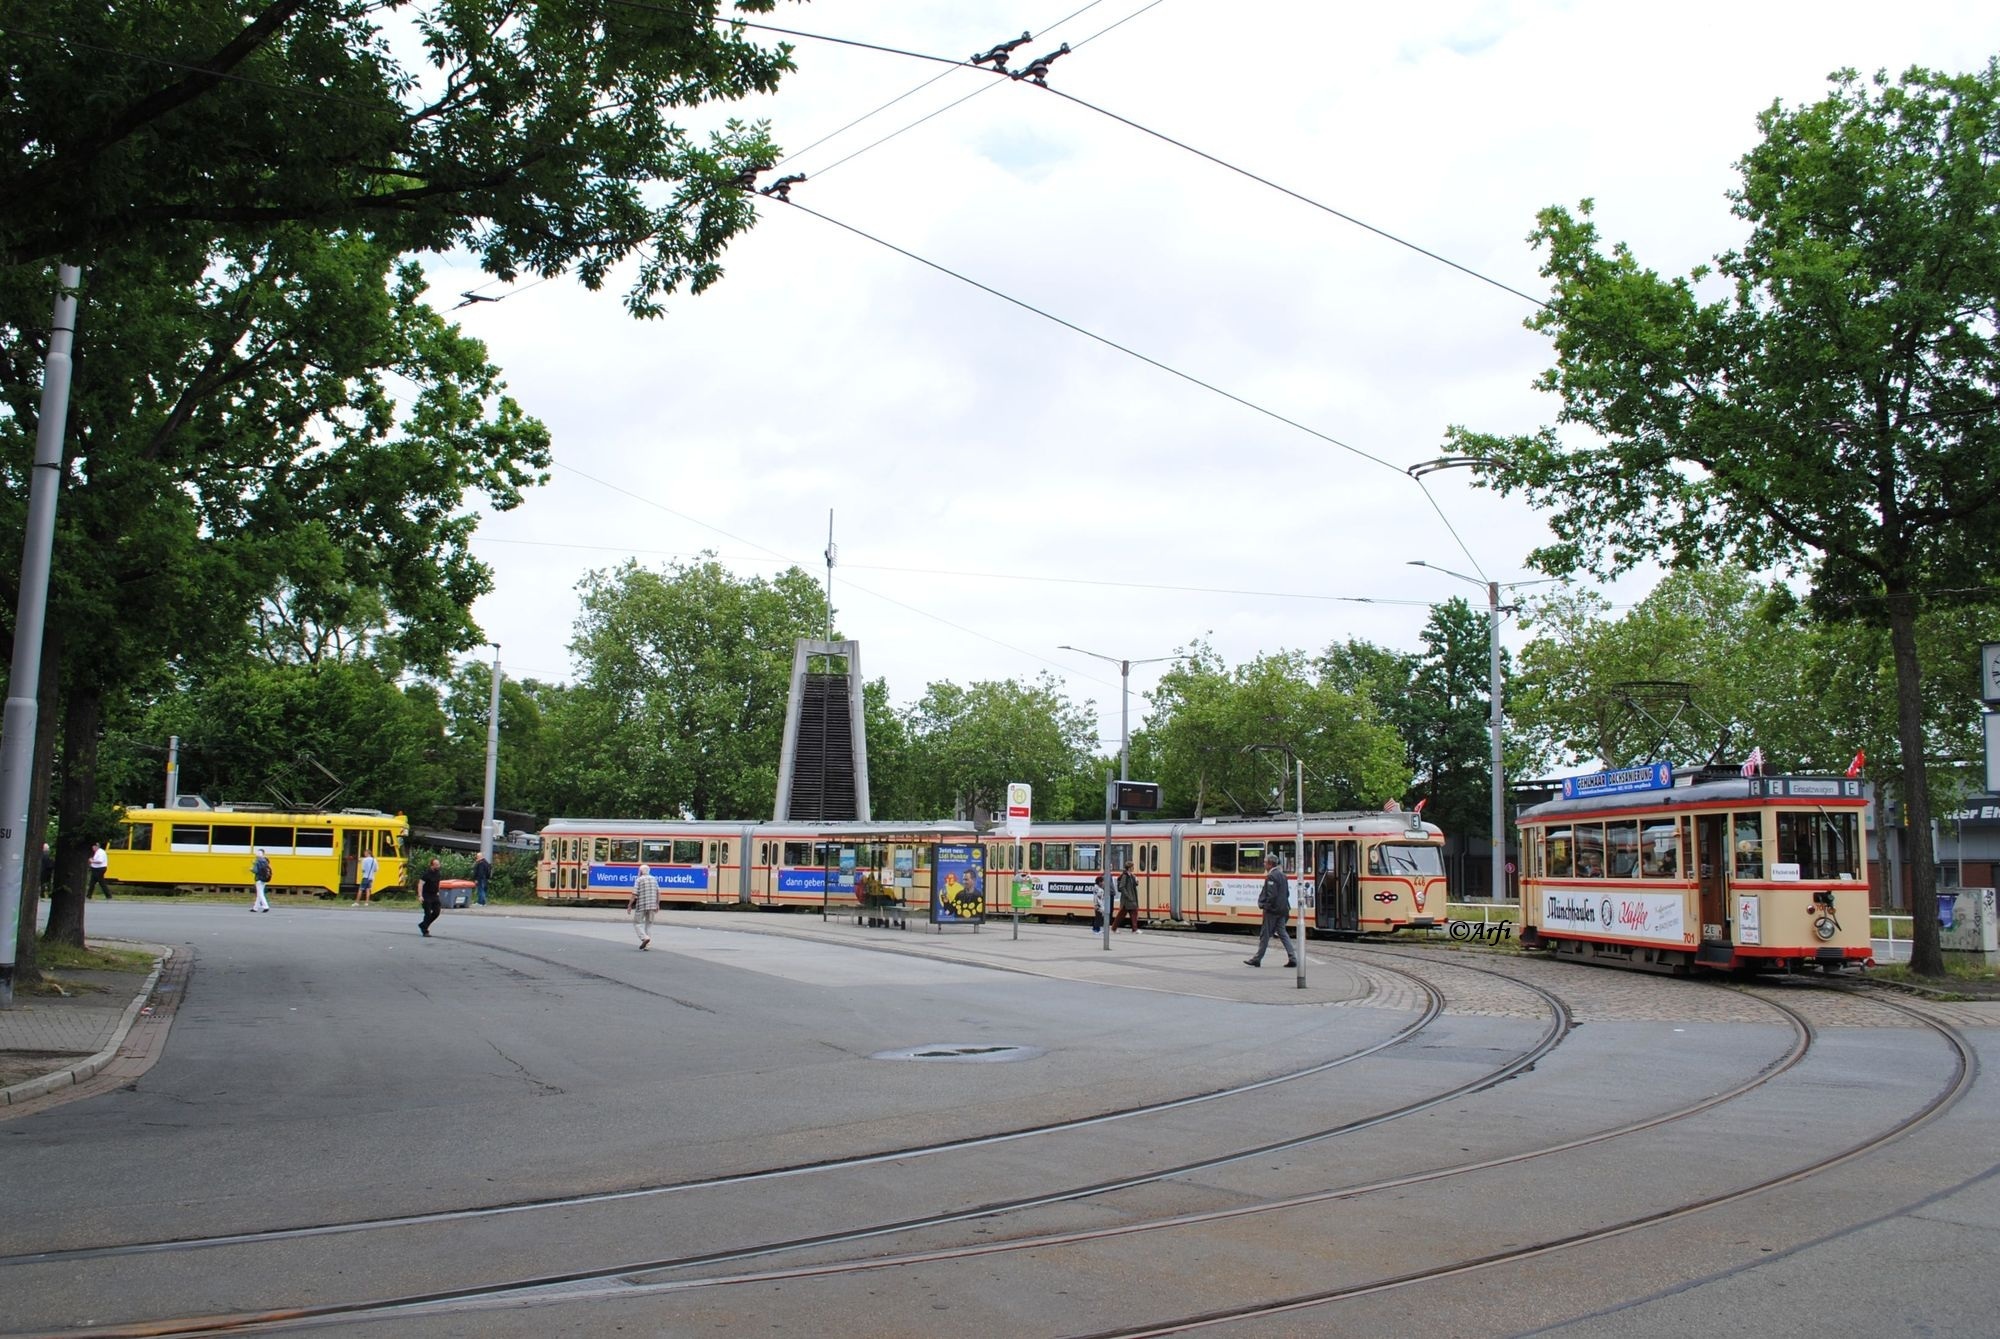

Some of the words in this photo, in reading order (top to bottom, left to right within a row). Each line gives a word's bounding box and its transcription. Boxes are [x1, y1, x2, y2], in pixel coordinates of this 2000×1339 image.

[1577, 774, 1606, 789] GEHLHAAR
[1609, 767, 1653, 786] DACHSANIERUNG
[1772, 781, 1779, 795] E
[1848, 782, 1855, 795] E
[596, 873, 618, 881] Wenn
[619, 874, 628, 882] es
[664, 875, 695, 884] ruckelt.
[785, 877, 803, 887] dann
[803, 878, 825, 889] geben
[1031, 883, 1044, 891] ZUL
[1208, 887, 1226, 896] AZUL
[1618, 901, 1651, 931] Kaffee
[1683, 933, 1695, 944] 701
